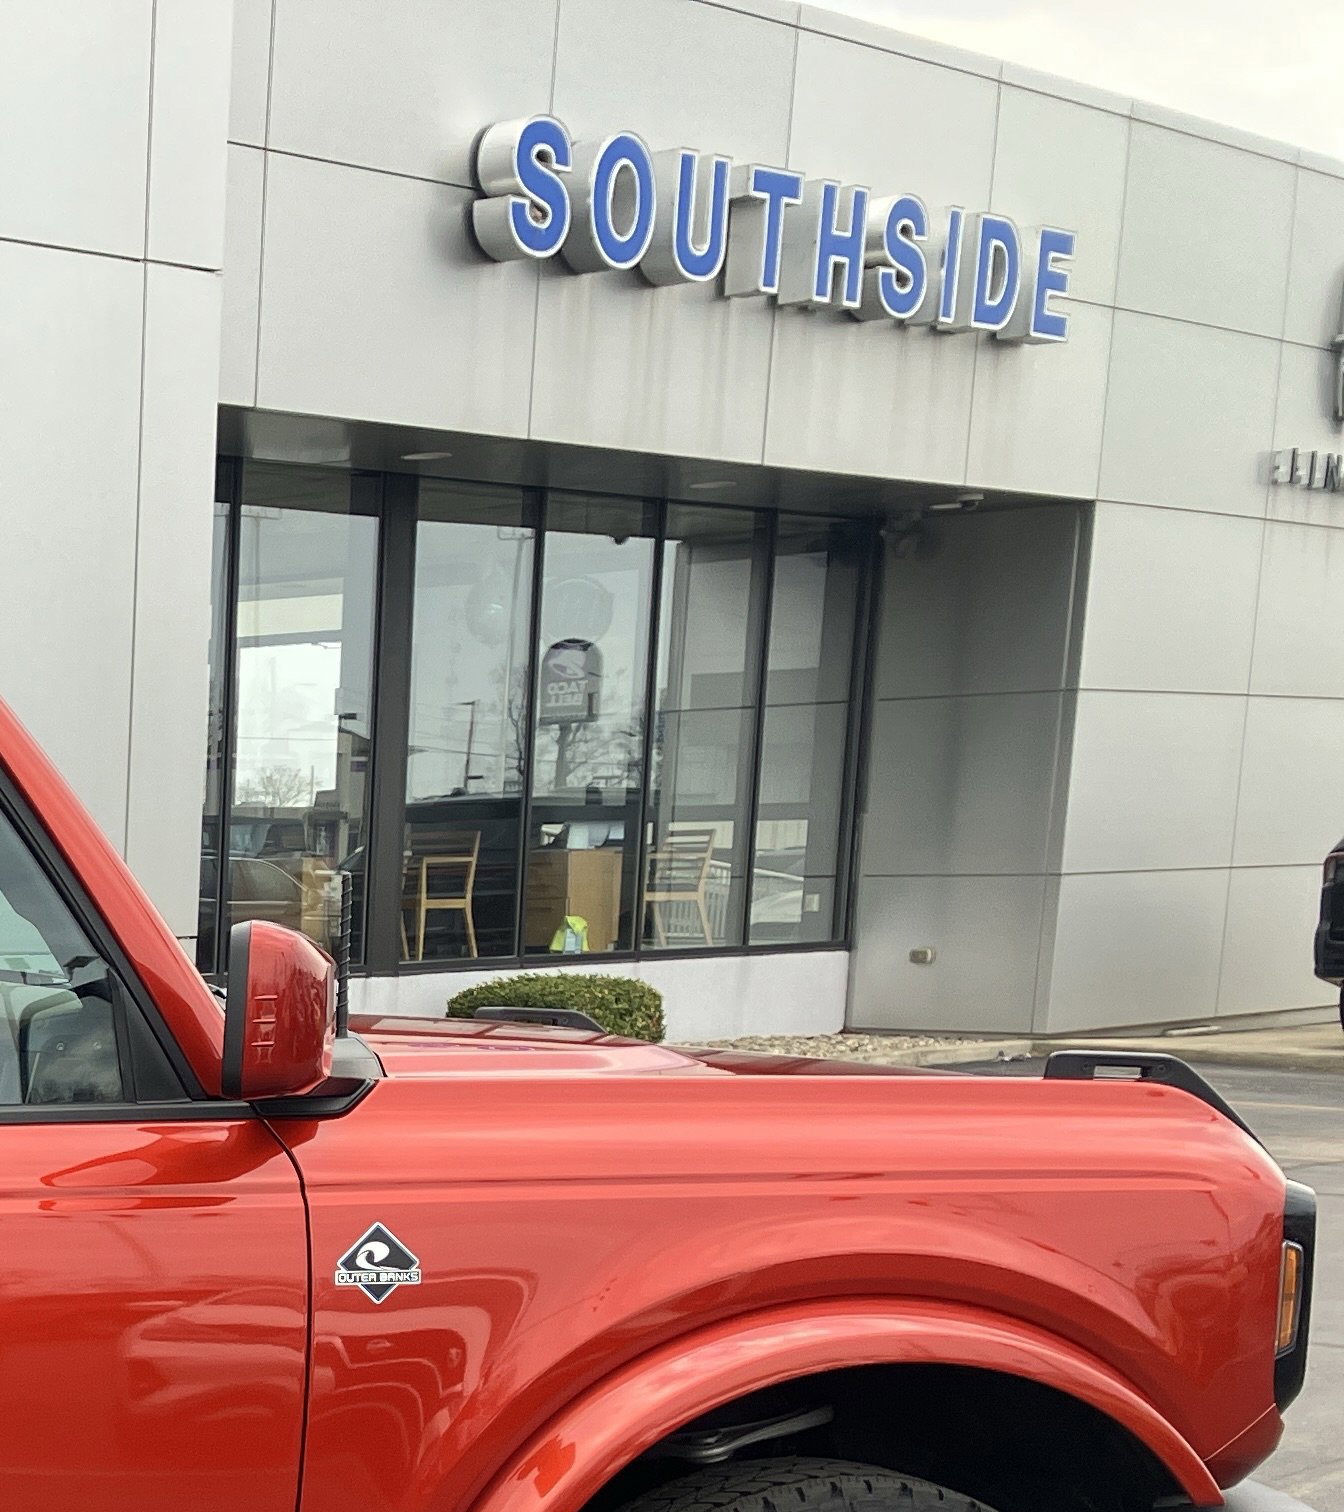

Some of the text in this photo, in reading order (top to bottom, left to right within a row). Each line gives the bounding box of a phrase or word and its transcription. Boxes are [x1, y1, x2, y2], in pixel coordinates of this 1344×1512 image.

[502, 113, 1079, 344] SOUTHSIDE
[338, 1271, 419, 1284] OUTER BANKS
